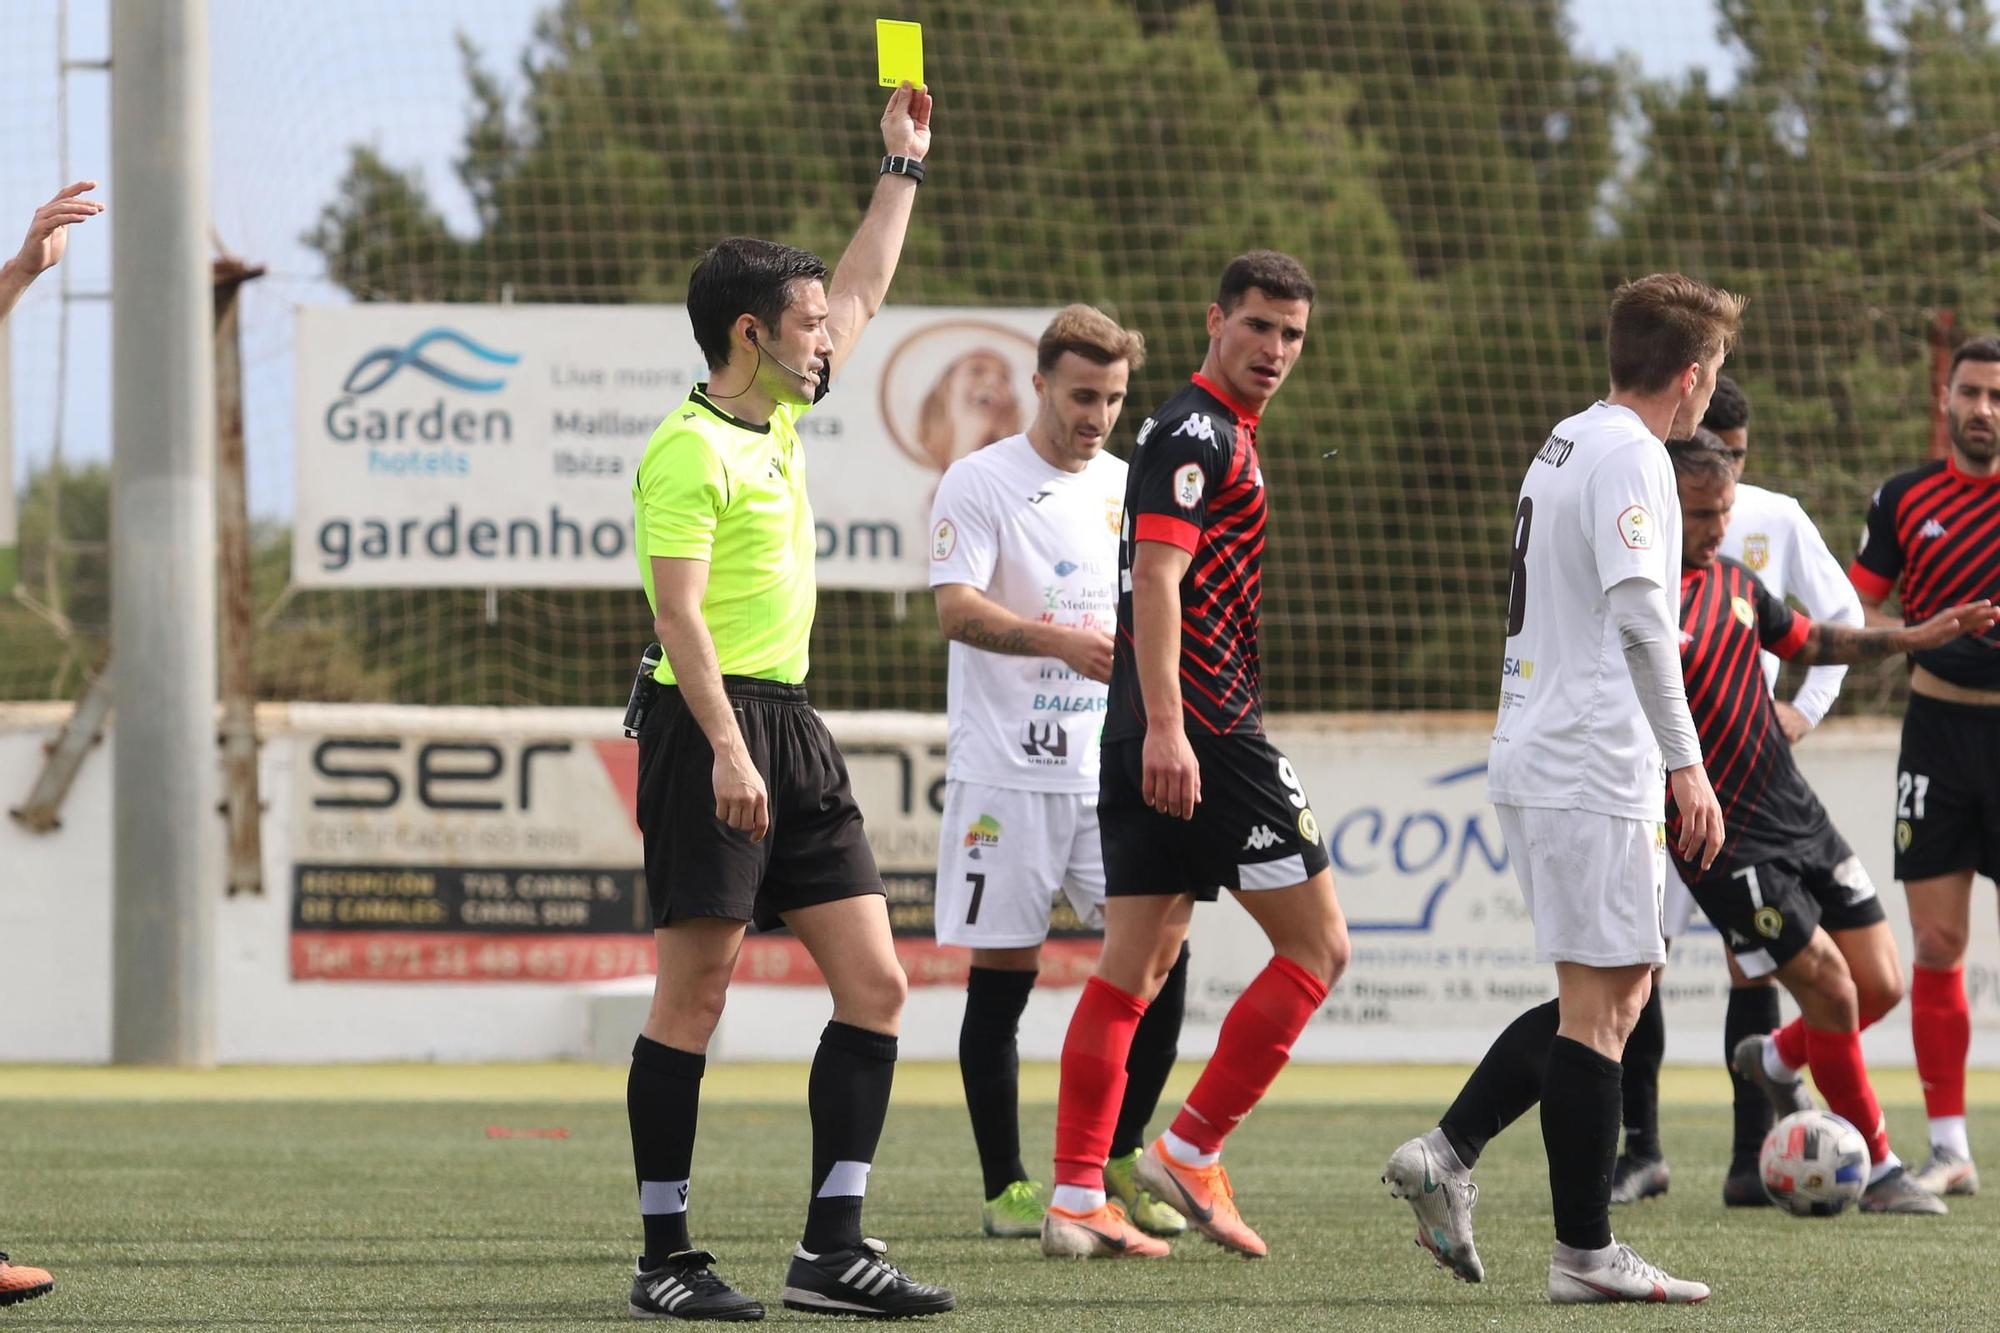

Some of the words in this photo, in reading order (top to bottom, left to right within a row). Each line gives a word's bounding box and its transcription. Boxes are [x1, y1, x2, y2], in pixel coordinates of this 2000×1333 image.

[325, 399, 514, 444] Garden
[367, 449, 470, 477] hotels
[312, 738, 573, 811] ser
[1027, 756, 1067, 766] UNIDAD
[1278, 756, 1307, 809] 9
[966, 872, 986, 925] 7
[1731, 866, 1764, 909] 7
